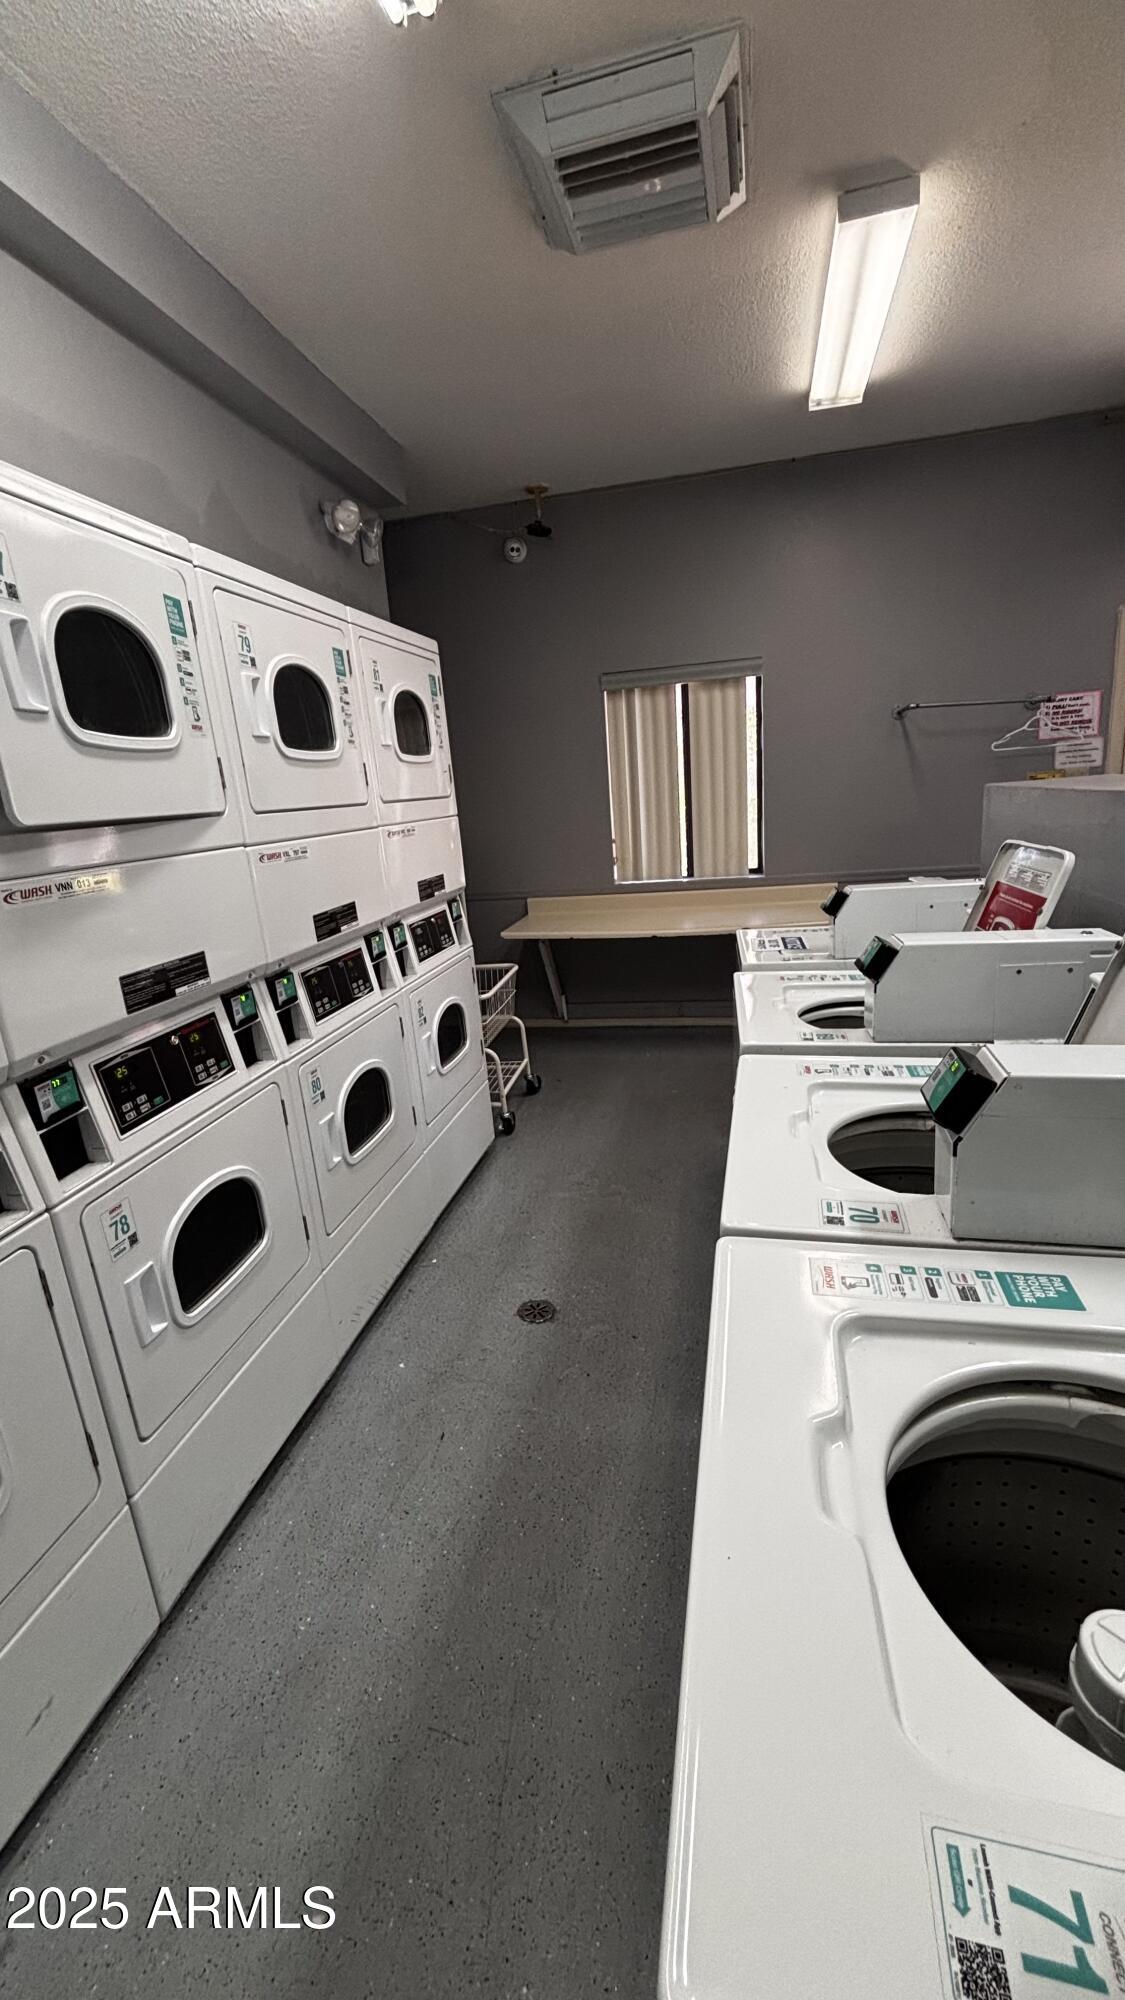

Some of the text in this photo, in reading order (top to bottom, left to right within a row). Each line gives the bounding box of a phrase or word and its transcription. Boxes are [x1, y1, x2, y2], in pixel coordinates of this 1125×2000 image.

[238, 634, 252, 654] 79
[20, 884, 53, 900] WASH
[54, 881, 74, 892] VNN
[76, 878, 91, 889] 013
[312, 1076, 322, 1094] 80
[848, 1206, 880, 1224] 70
[109, 1214, 130, 1241] 78
[823, 1266, 836, 1290] WASH
[1014, 1274, 1036, 1304] PHONE
[1026, 1276, 1046, 1298] YOUR
[1038, 1276, 1058, 1297] WITH
[1050, 1276, 1067, 1292] PAY
[1007, 1885, 1109, 1995] 71
